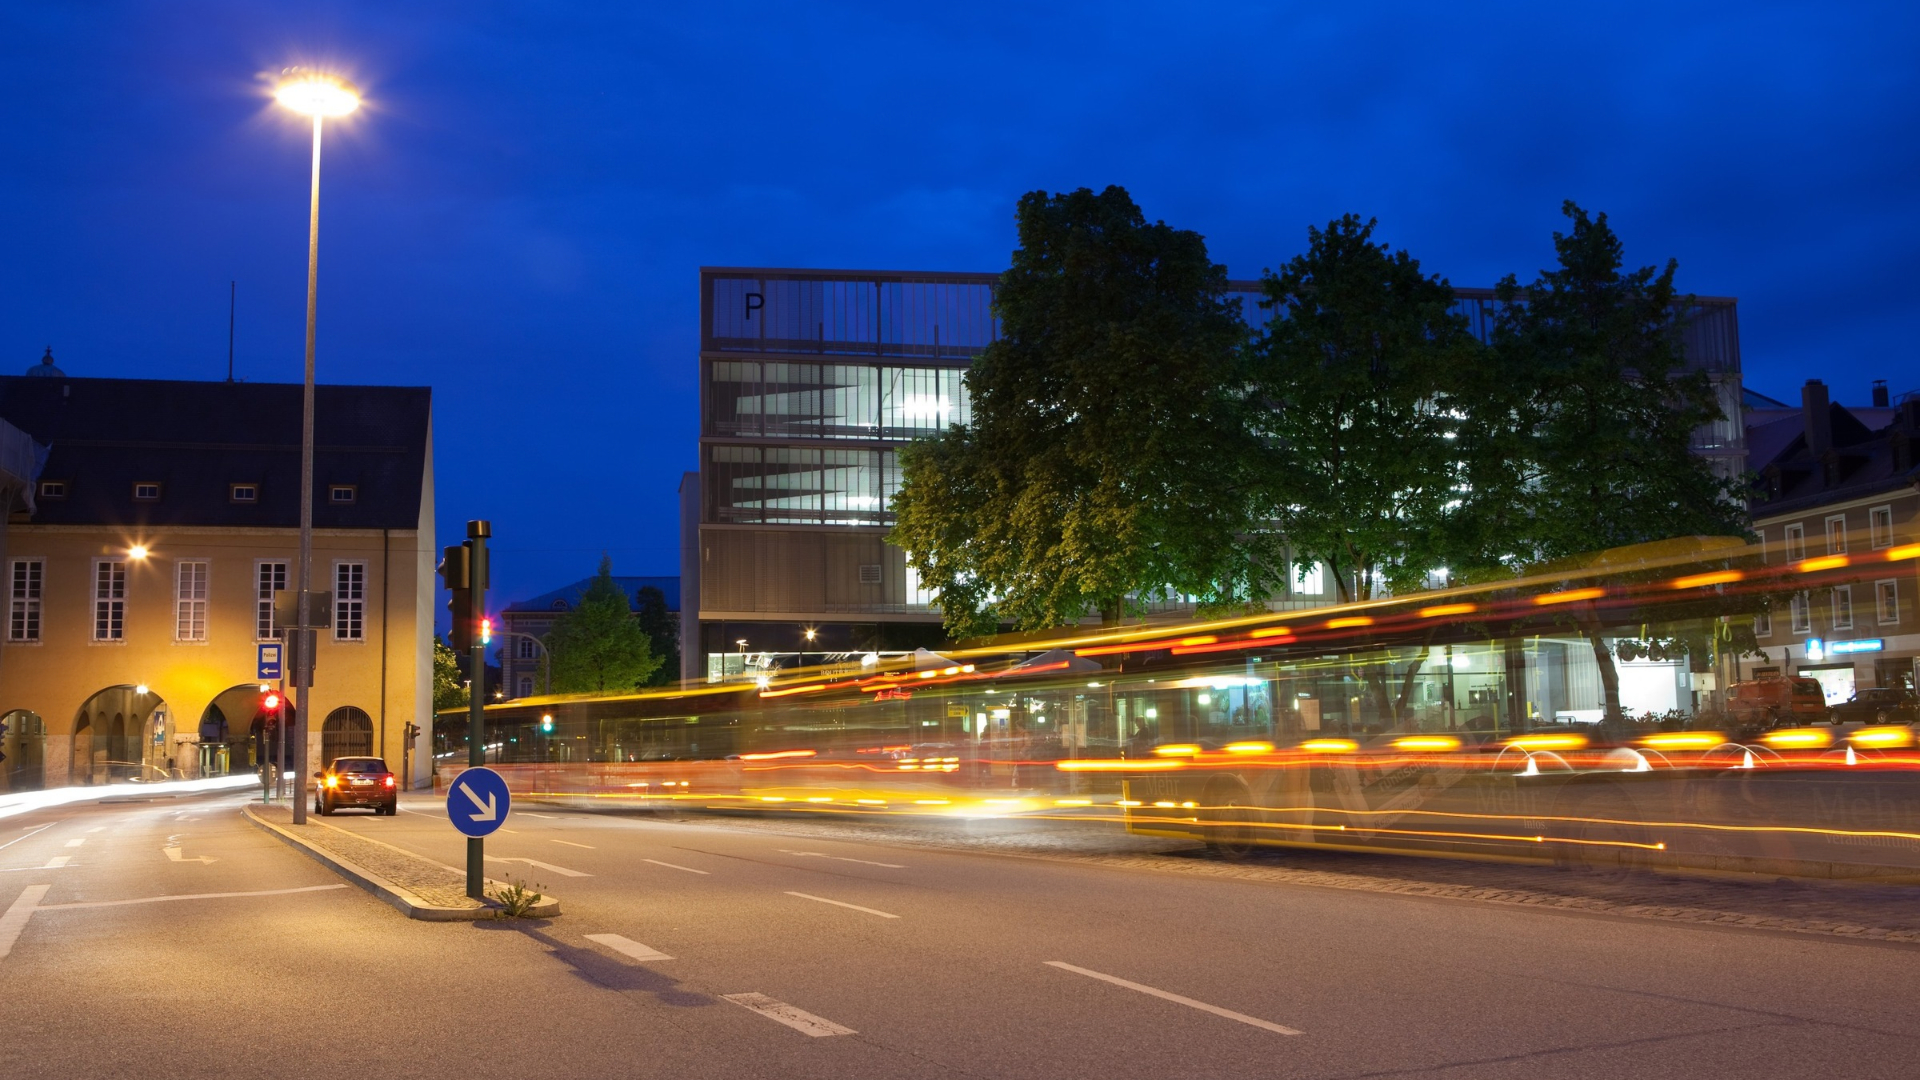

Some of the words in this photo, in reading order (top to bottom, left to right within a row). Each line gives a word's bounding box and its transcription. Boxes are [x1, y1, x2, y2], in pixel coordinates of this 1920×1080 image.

[745, 292, 765, 320] P
[1145, 772, 1180, 796] Mehr
[1475, 776, 1540, 814] Mehr
[1373, 794, 1423, 829] Regenburg
[1811, 783, 1920, 826] Mehr
[1523, 816, 1549, 831] Infos.
